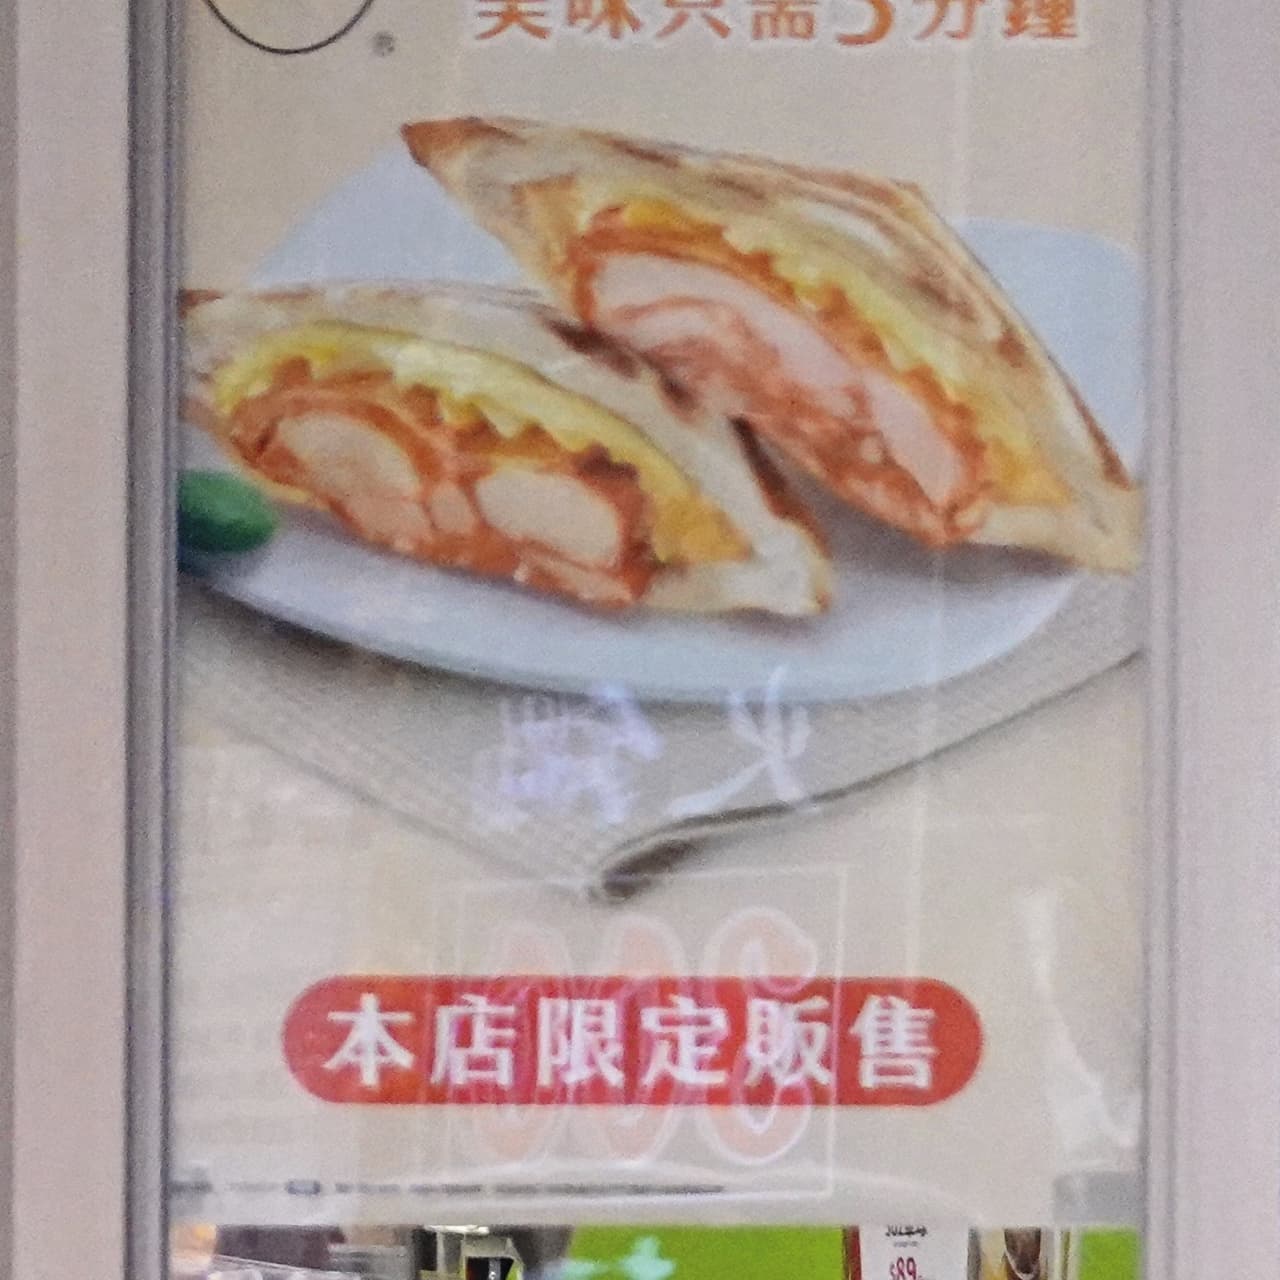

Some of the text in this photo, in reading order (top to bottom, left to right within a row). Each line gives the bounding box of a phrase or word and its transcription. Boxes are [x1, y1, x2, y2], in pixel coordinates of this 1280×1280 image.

[325, 995, 938, 1092] 本店限定販售
